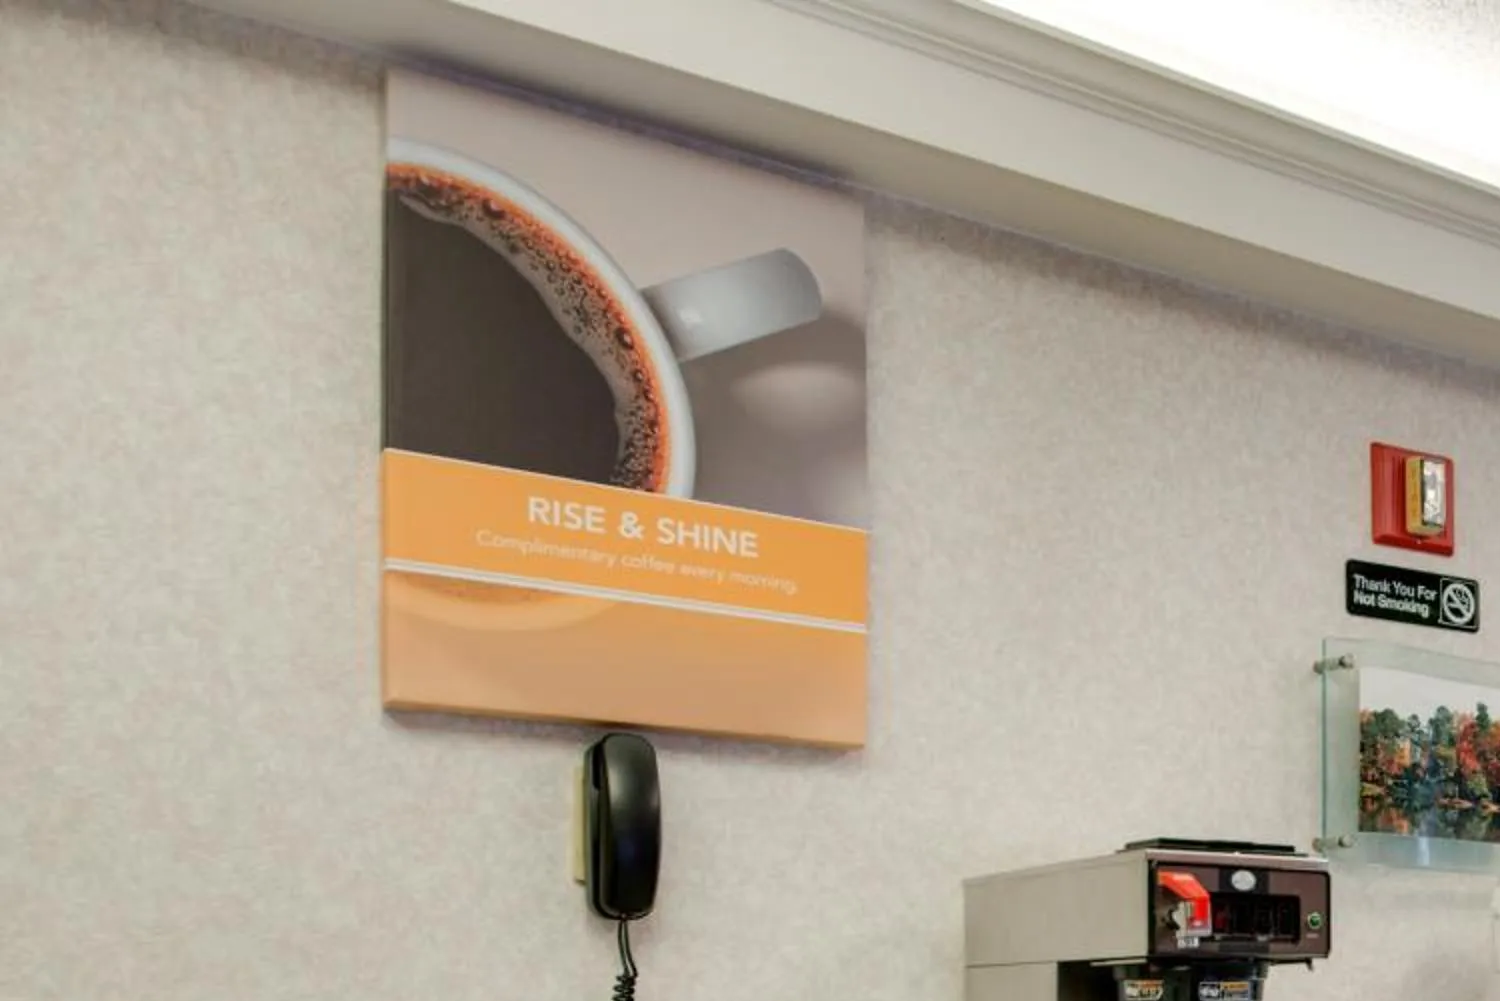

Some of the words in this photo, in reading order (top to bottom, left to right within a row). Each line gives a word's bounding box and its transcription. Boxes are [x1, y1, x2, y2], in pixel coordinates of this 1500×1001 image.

[528, 496, 607, 535] RISE
[617, 511, 645, 541] &
[656, 517, 760, 559] SHINE
[475, 528, 617, 568] Complimentary
[620, 551, 675, 575] coffee
[679, 563, 728, 585] every
[730, 570, 798, 596] morning
[1353, 573, 1392, 594] Thank
[1392, 580, 1415, 597] You
[1417, 585, 1438, 601] For
[1353, 589, 1376, 607] Not
[1377, 593, 1430, 619] Smoking
